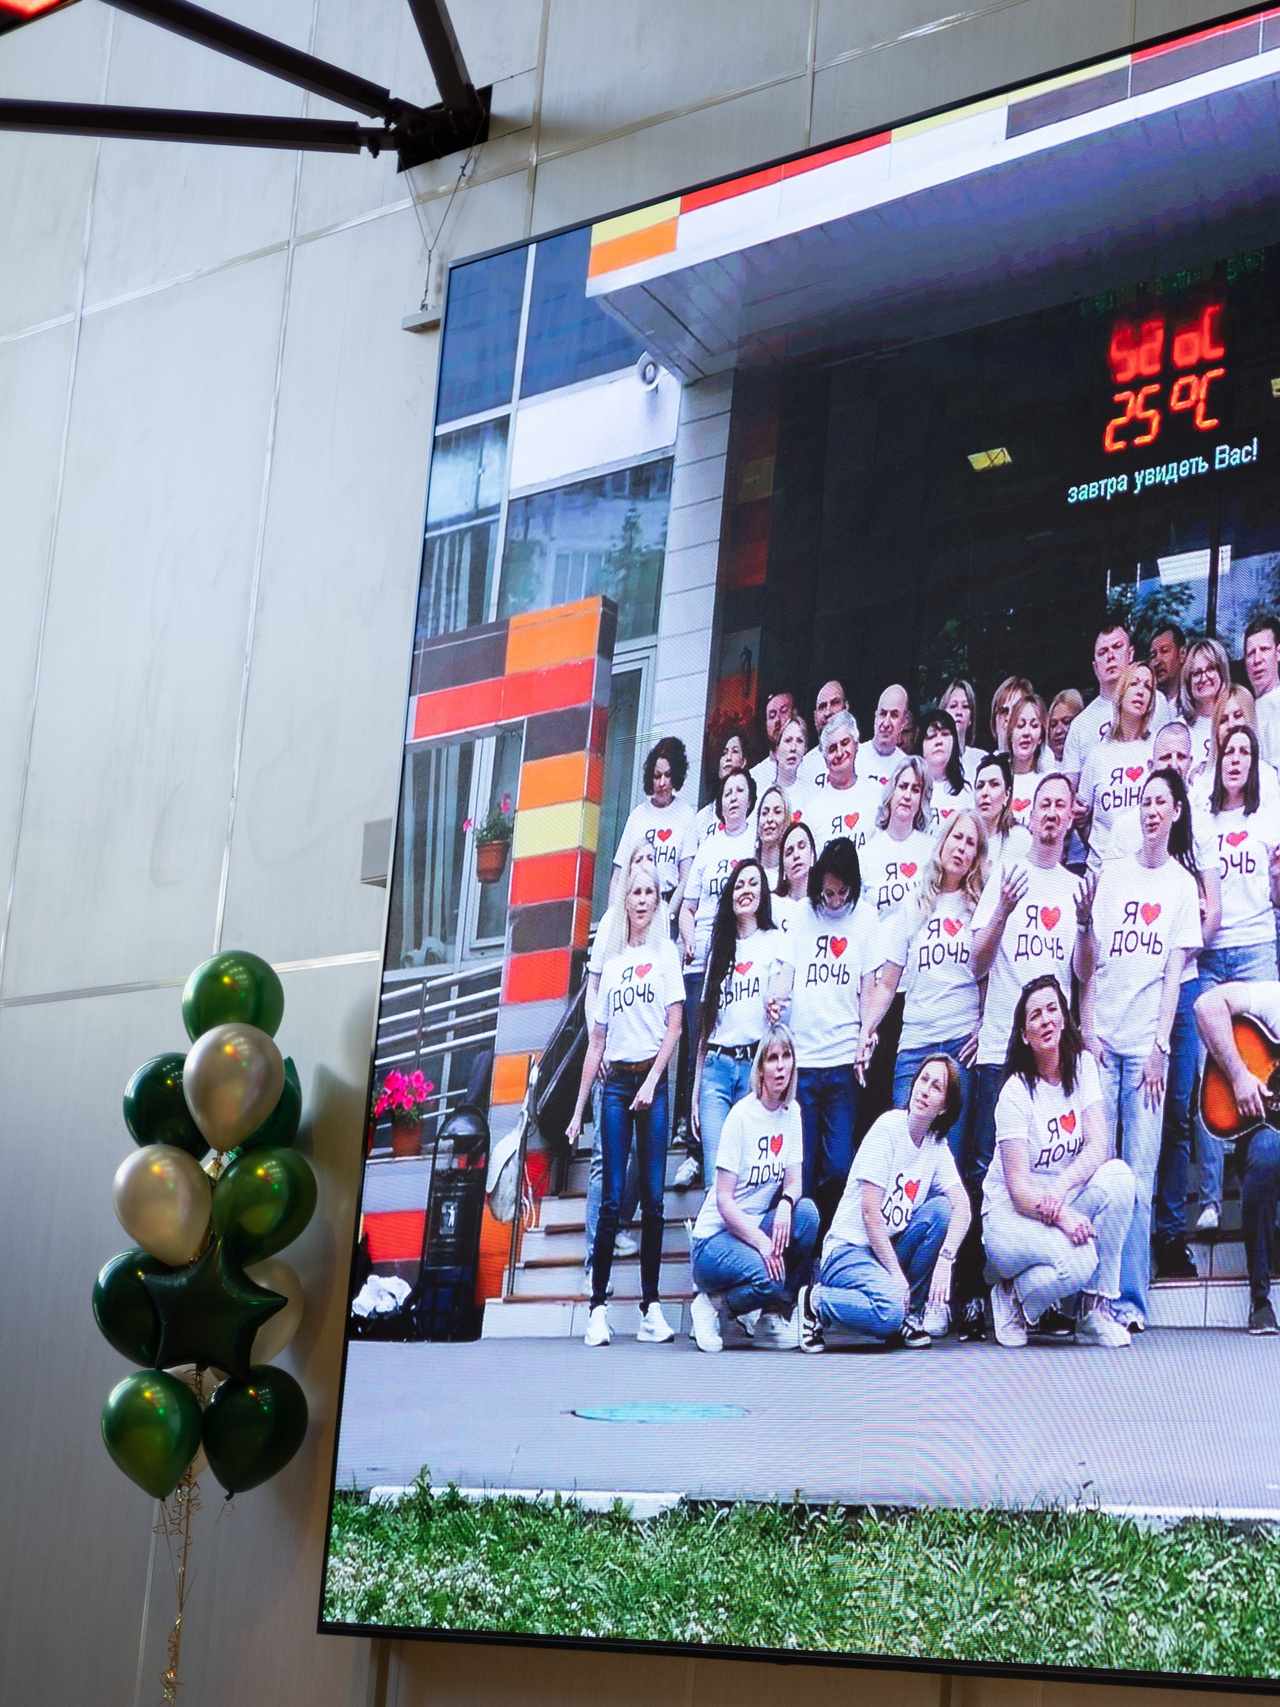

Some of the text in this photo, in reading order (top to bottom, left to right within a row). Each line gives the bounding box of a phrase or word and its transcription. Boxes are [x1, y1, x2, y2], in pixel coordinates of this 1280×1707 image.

[1103, 382, 1162, 453] 25
[1067, 436, 1259, 504] завтра увидеть Вас!
[1110, 767, 1124, 787] Я
[1101, 786, 1142, 812] СЫН
[832, 815, 843, 834] Я
[717, 860, 729, 874] Я
[885, 862, 898, 882] Я
[1026, 904, 1038, 930] Я
[1122, 900, 1140, 926] Я
[927, 918, 941, 940] Я
[815, 934, 829, 959] Я
[918, 941, 970, 972] ДОЧЬ
[1014, 933, 1065, 962] ДОЧЬ
[1109, 930, 1164, 958] ДОЧЬ
[620, 965, 634, 985] Я
[805, 962, 851, 988] ДОЧЬ
[612, 983, 655, 1016] ДОЧЬ
[1047, 1117, 1060, 1144] Я
[757, 1136, 769, 1160] Я
